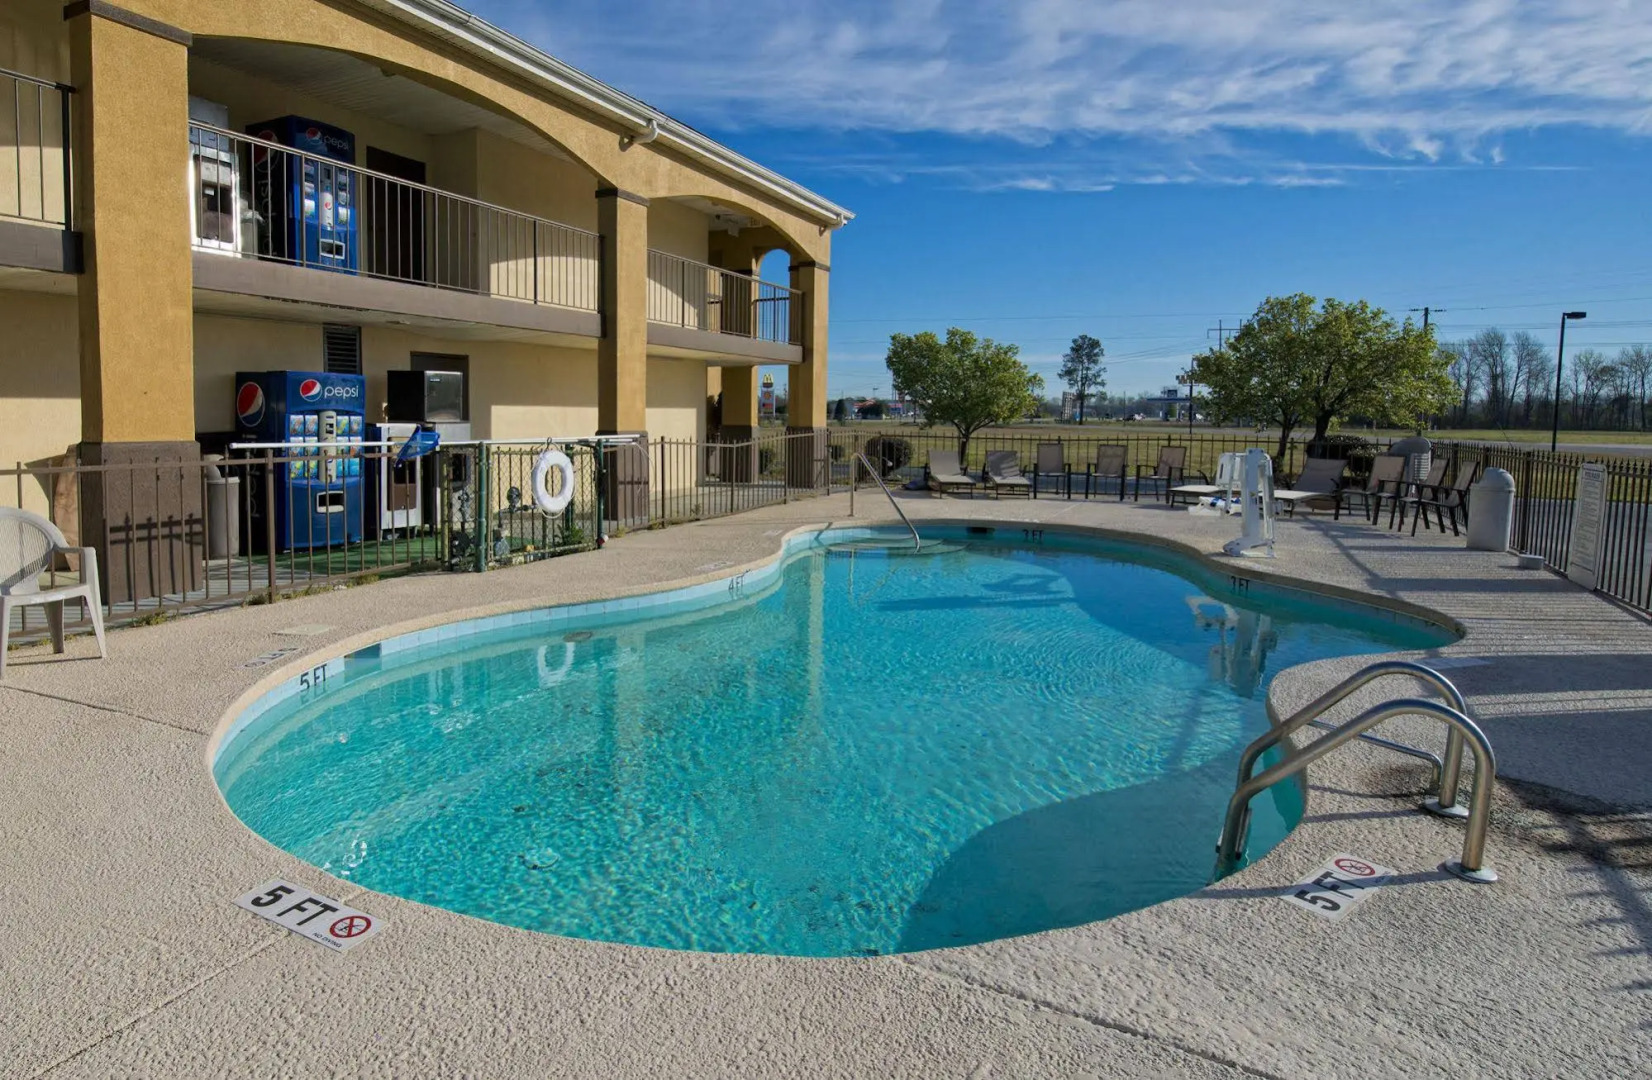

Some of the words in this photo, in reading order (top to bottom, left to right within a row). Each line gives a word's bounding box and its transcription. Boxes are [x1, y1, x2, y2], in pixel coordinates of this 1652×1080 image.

[324, 386, 359, 400] pepsi
[300, 671, 310, 692] 5
[313, 663, 327, 687] FT
[1311, 870, 1365, 899] FT
[250, 885, 295, 907] 5
[276, 896, 339, 926] FT
[1294, 889, 1341, 912] 5
